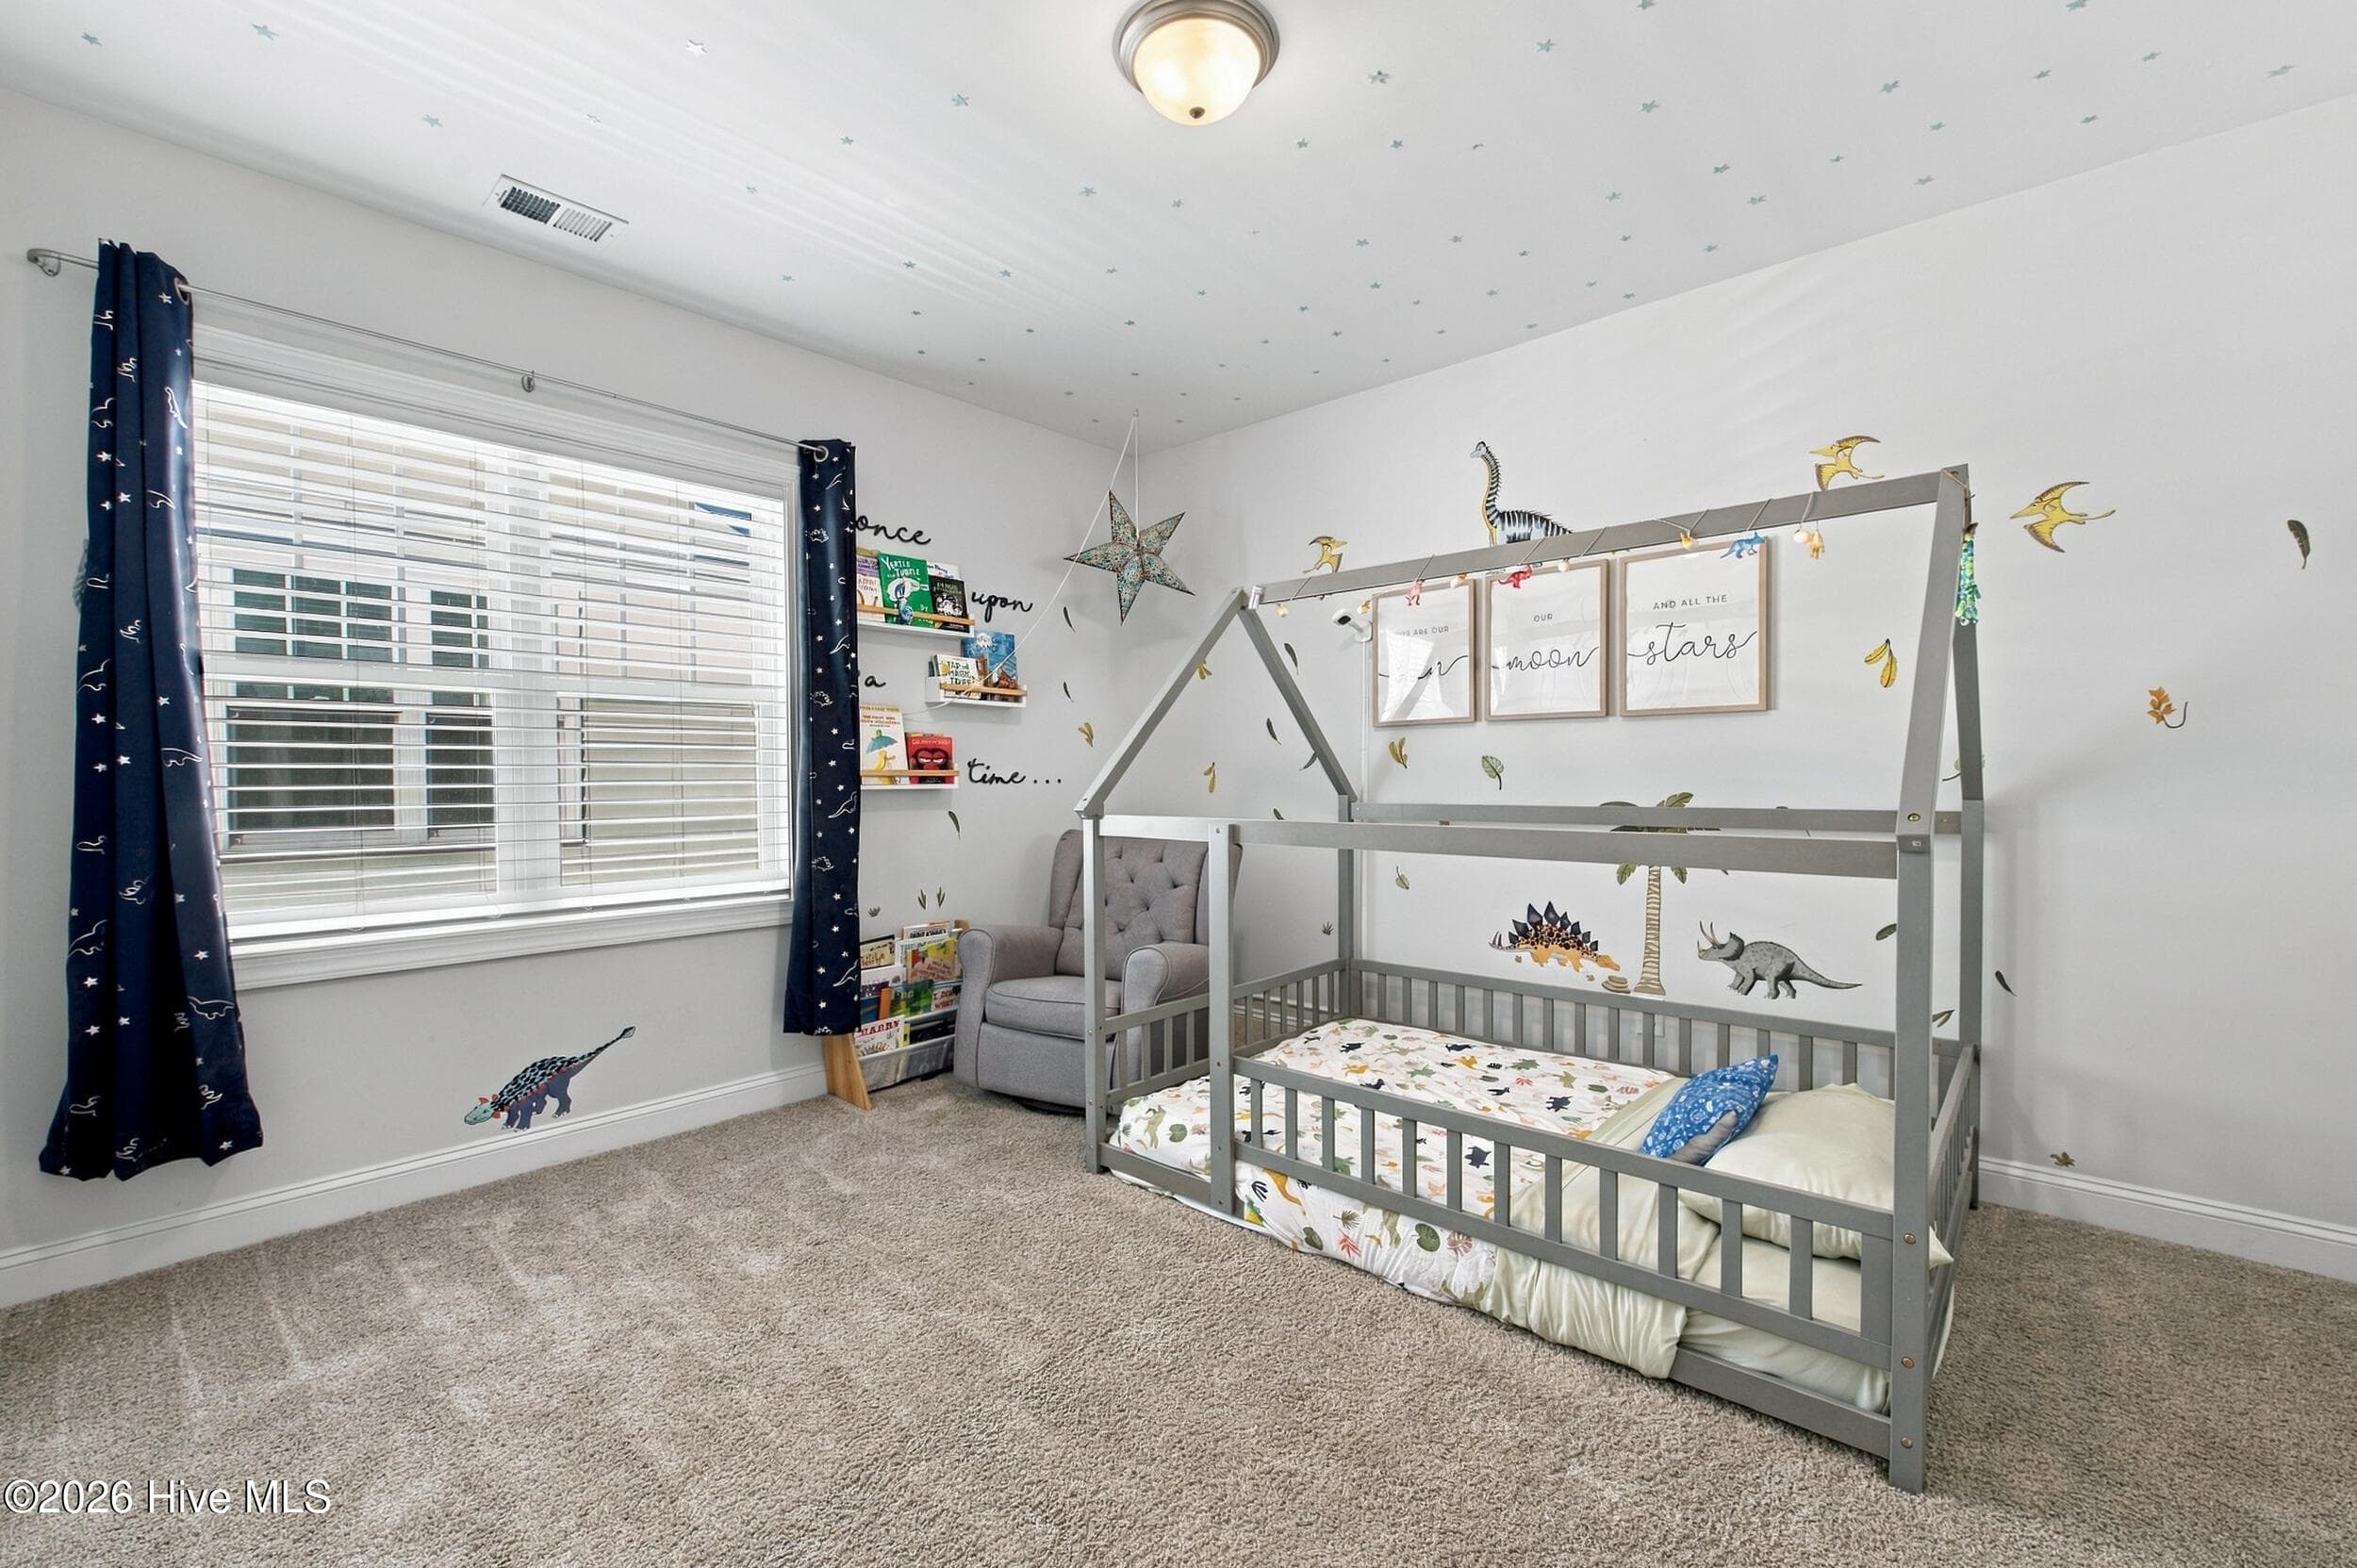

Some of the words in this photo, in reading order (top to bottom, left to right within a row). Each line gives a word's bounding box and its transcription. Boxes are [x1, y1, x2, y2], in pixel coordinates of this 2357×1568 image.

[855, 515, 931, 545] once
[971, 591, 1033, 623] upon
[1652, 601, 1676, 610] AND
[1681, 598, 1700, 607] ALL
[1706, 594, 1728, 604] THE
[1533, 613, 1554, 622] OUR
[1431, 625, 1449, 635] OUR
[1627, 622, 1757, 666] stars
[1492, 647, 1600, 671] moon
[865, 675, 886, 687] a
